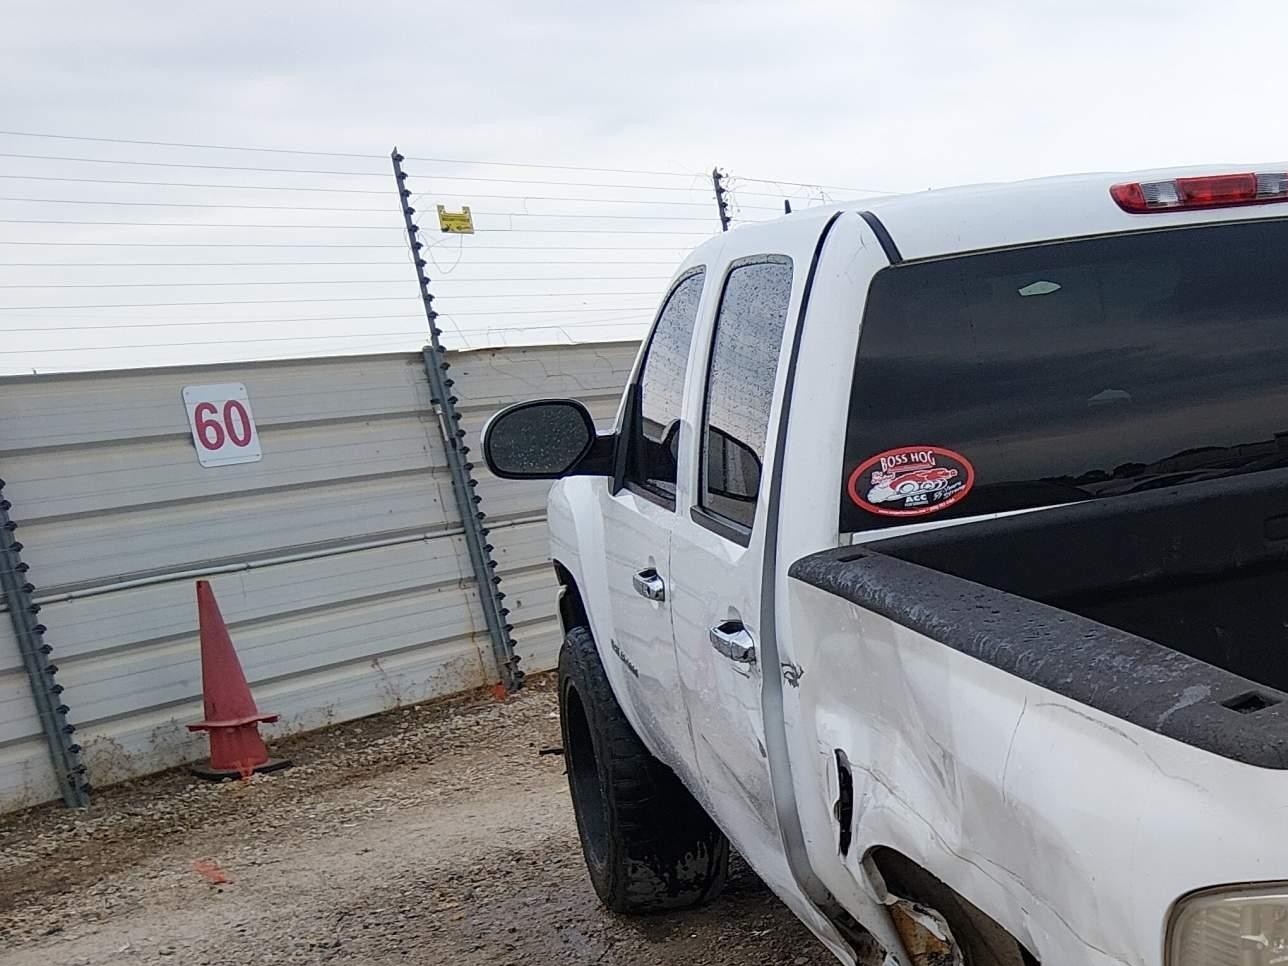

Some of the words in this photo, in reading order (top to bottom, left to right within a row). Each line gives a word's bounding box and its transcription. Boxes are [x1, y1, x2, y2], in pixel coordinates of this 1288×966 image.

[194, 399, 252, 451] 60
[880, 453, 908, 472] BOSS
[910, 450, 936, 465] HOG
[905, 494, 928, 503] ACC
